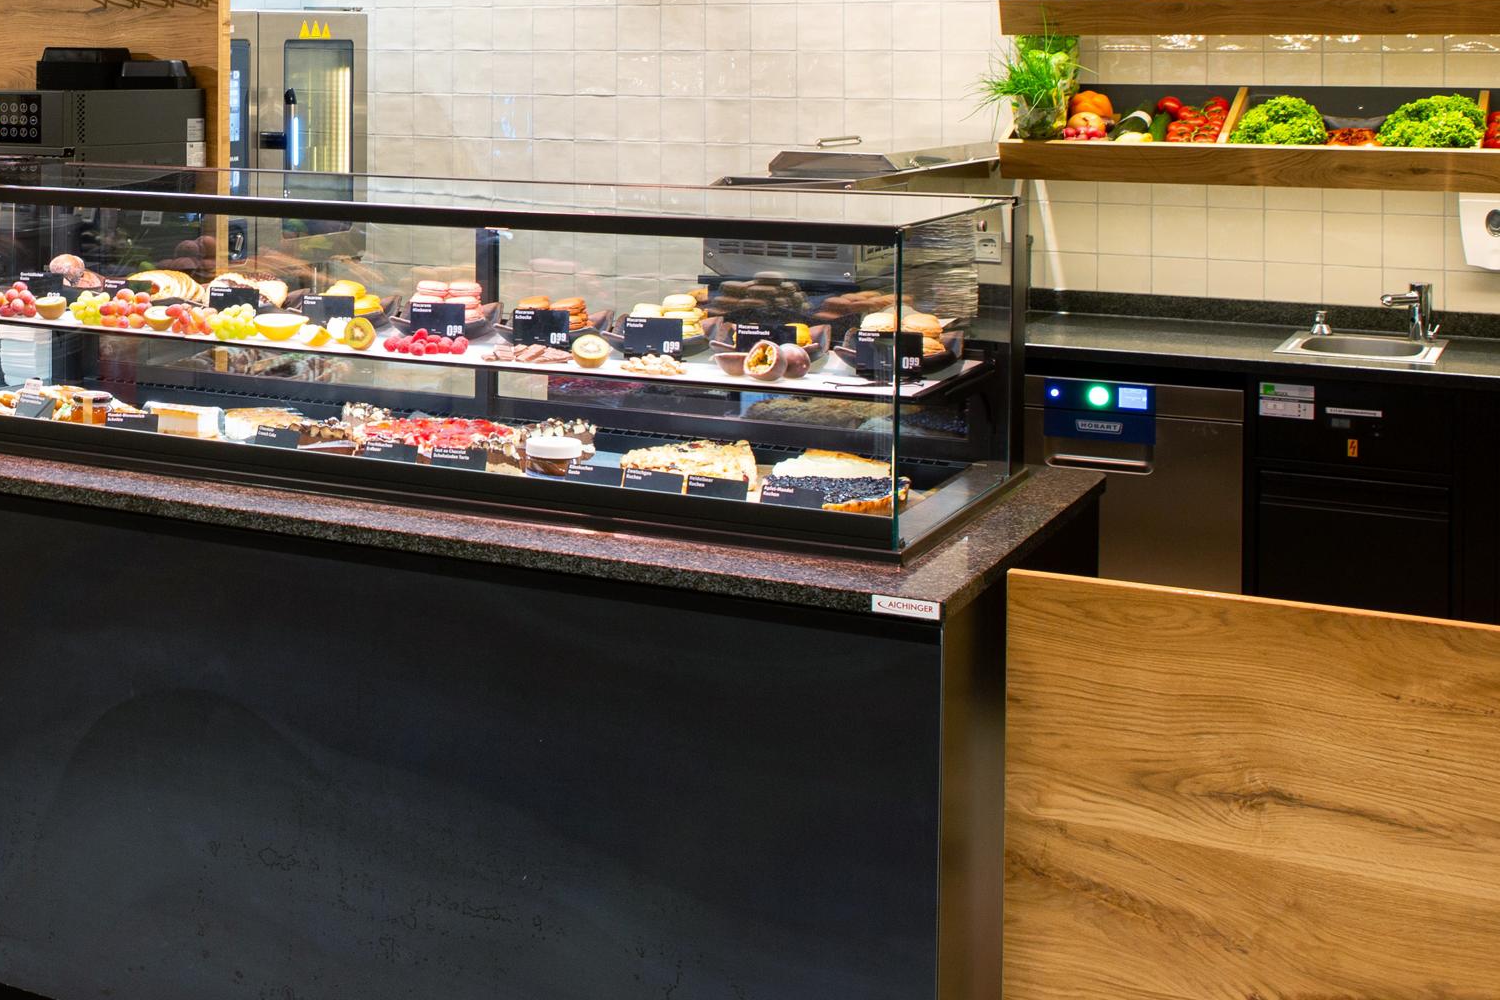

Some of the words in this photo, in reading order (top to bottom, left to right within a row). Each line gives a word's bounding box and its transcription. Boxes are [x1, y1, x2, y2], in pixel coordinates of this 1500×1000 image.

[446, 325, 462, 336] 0.99
[550, 333, 567, 344] 0.99
[662, 341, 680, 353] 0.99
[902, 357, 920, 369] 0.99
[888, 601, 933, 613] AICHINGER
